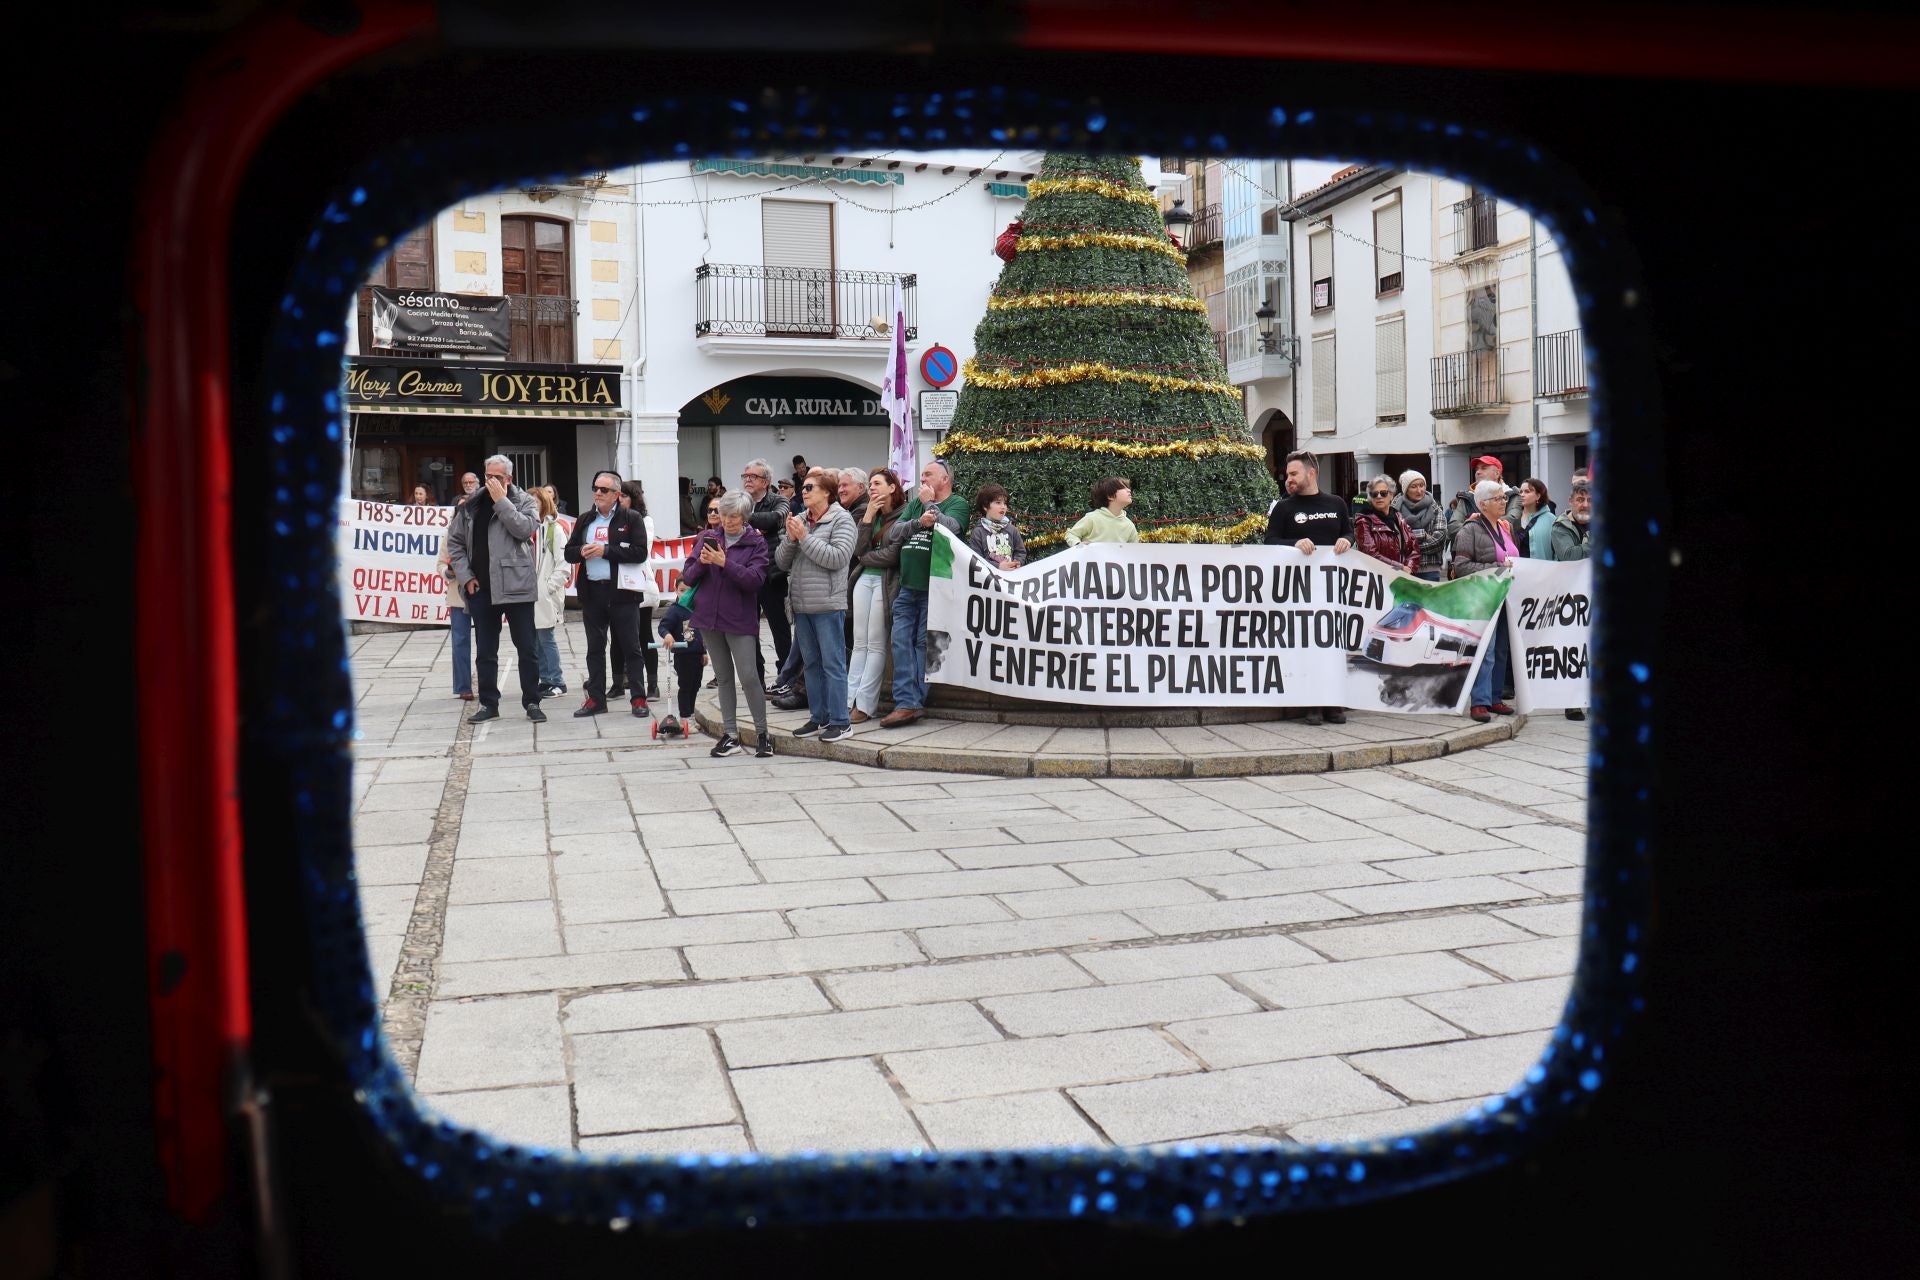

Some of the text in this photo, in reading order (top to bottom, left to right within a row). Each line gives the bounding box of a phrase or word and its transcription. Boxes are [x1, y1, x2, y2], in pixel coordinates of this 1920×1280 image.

[398, 292, 459, 309] sésamo
[407, 309, 429, 317] Cocina
[431, 319, 453, 327] Terraza
[463, 321, 484, 329] Verano
[459, 328, 477, 336] Barrio
[407, 335, 445, 343] 927473031
[345, 369, 391, 400] Mary
[398, 369, 463, 396] Carmen
[745, 398, 792, 417] CAJA
[795, 398, 857, 416] RURAL
[354, 528, 440, 556] INCOMU
[968, 554, 1385, 611] EXTREMADURA POR UN TREN
[411, 604, 429, 620] DE
[966, 594, 1364, 651] QUE VERTEBRE EL TERRITORIO
[965, 638, 983, 677] Y
[1106, 652, 1140, 693] EL
[1148, 654, 1285, 694] PLANETA
